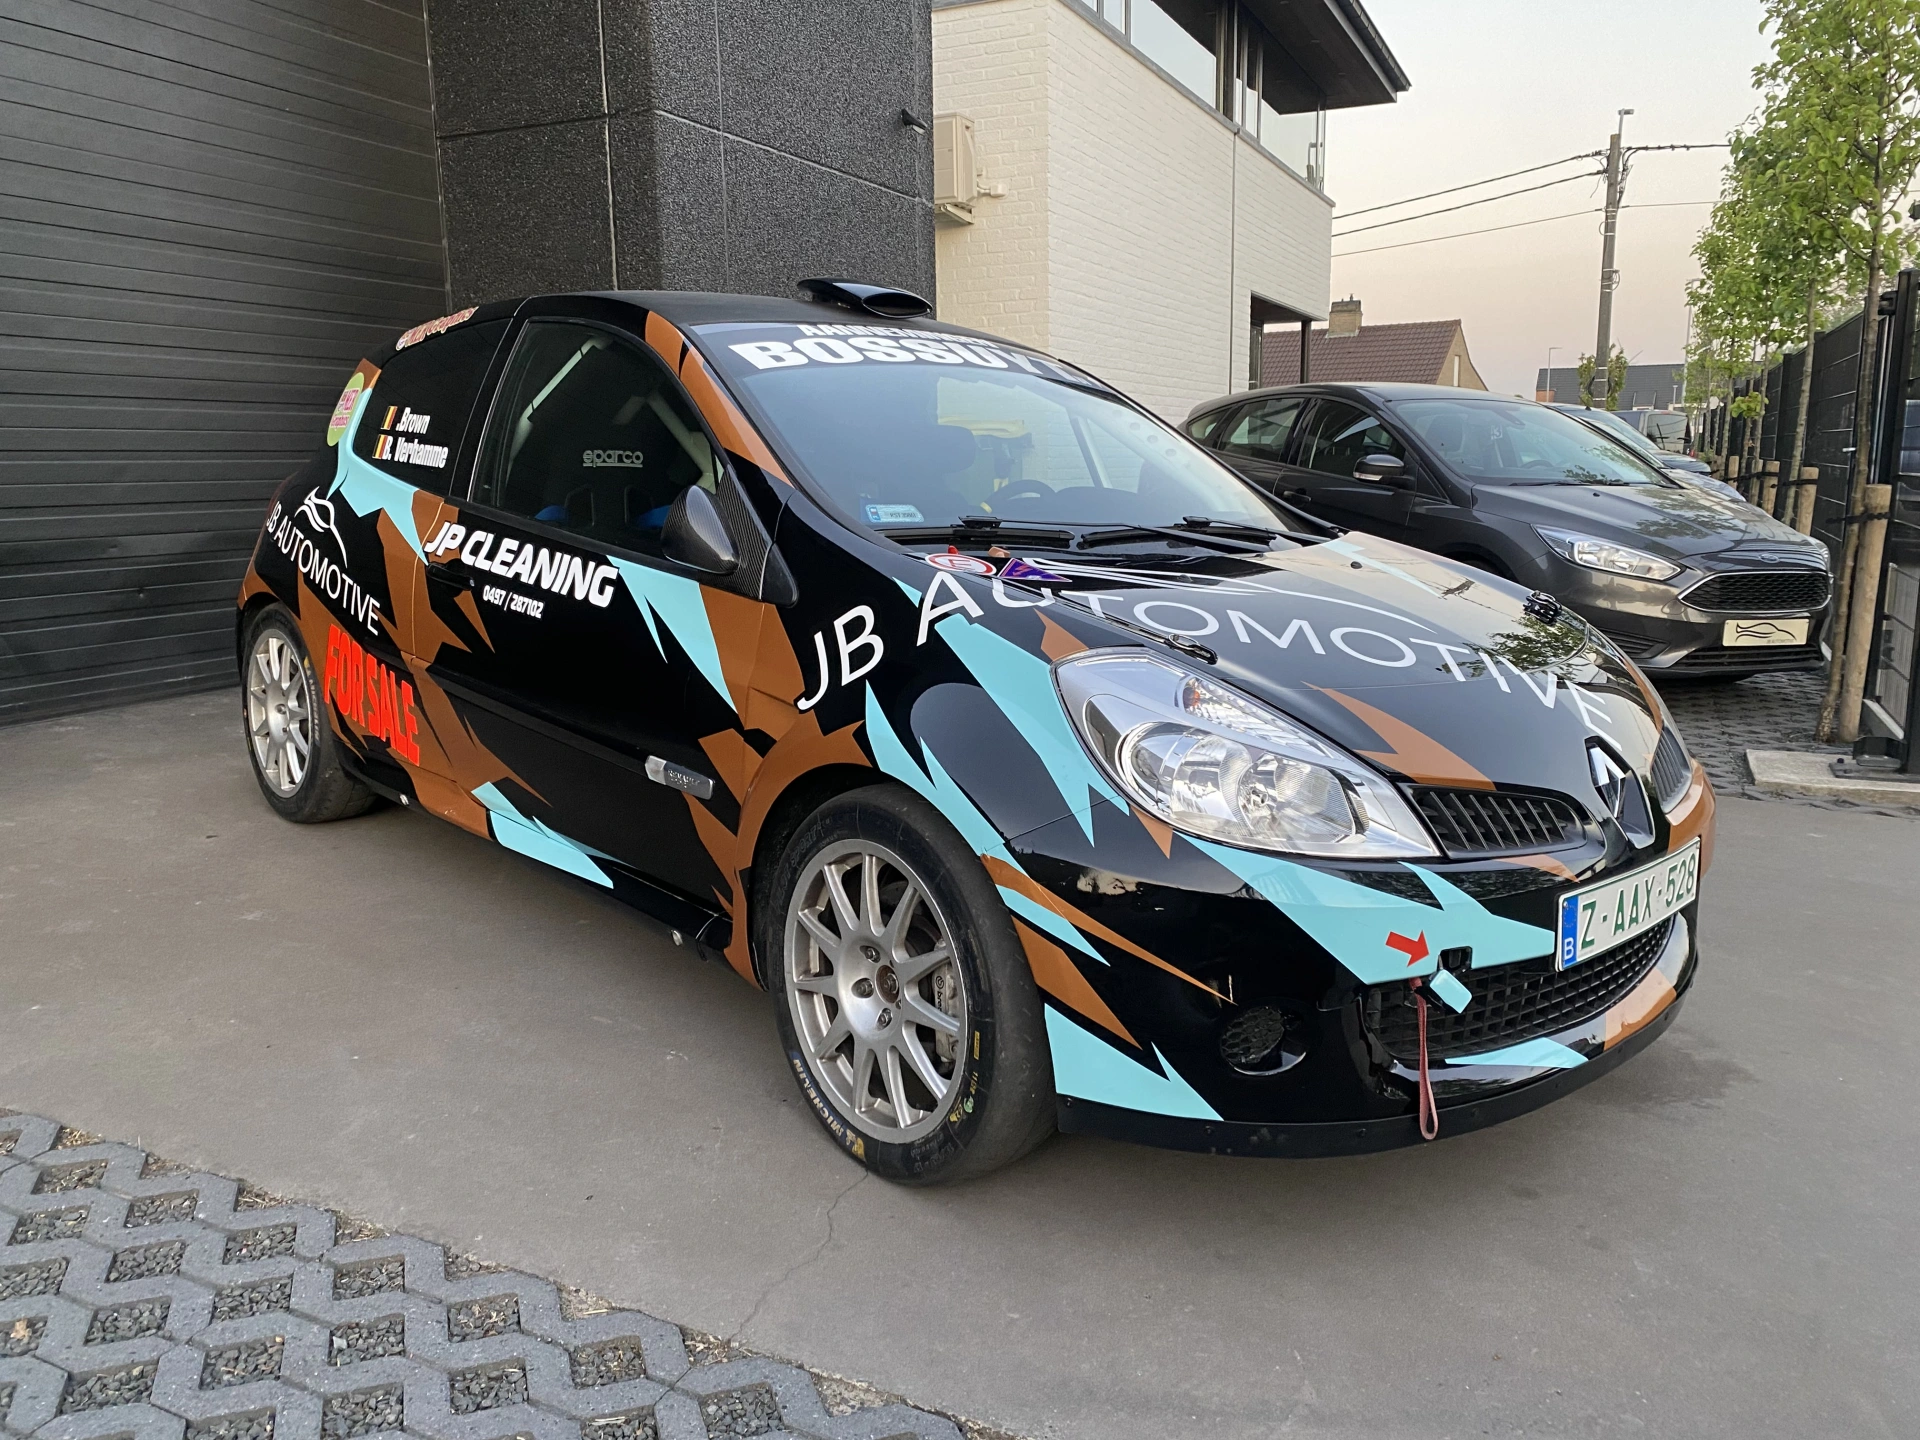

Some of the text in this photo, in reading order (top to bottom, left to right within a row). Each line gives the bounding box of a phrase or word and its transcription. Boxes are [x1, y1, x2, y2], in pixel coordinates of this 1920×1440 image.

[394, 436, 449, 469] Verhamme
[266, 500, 381, 637] JB AUTOMOTIVE
[423, 521, 620, 608] JP CLEANING
[324, 623, 421, 767] FOR SALE
[796, 571, 1623, 751] JB AUTOMOTIVE
[1564, 936, 1575, 961] B
[793, 1059, 844, 1137] MICHELIN
